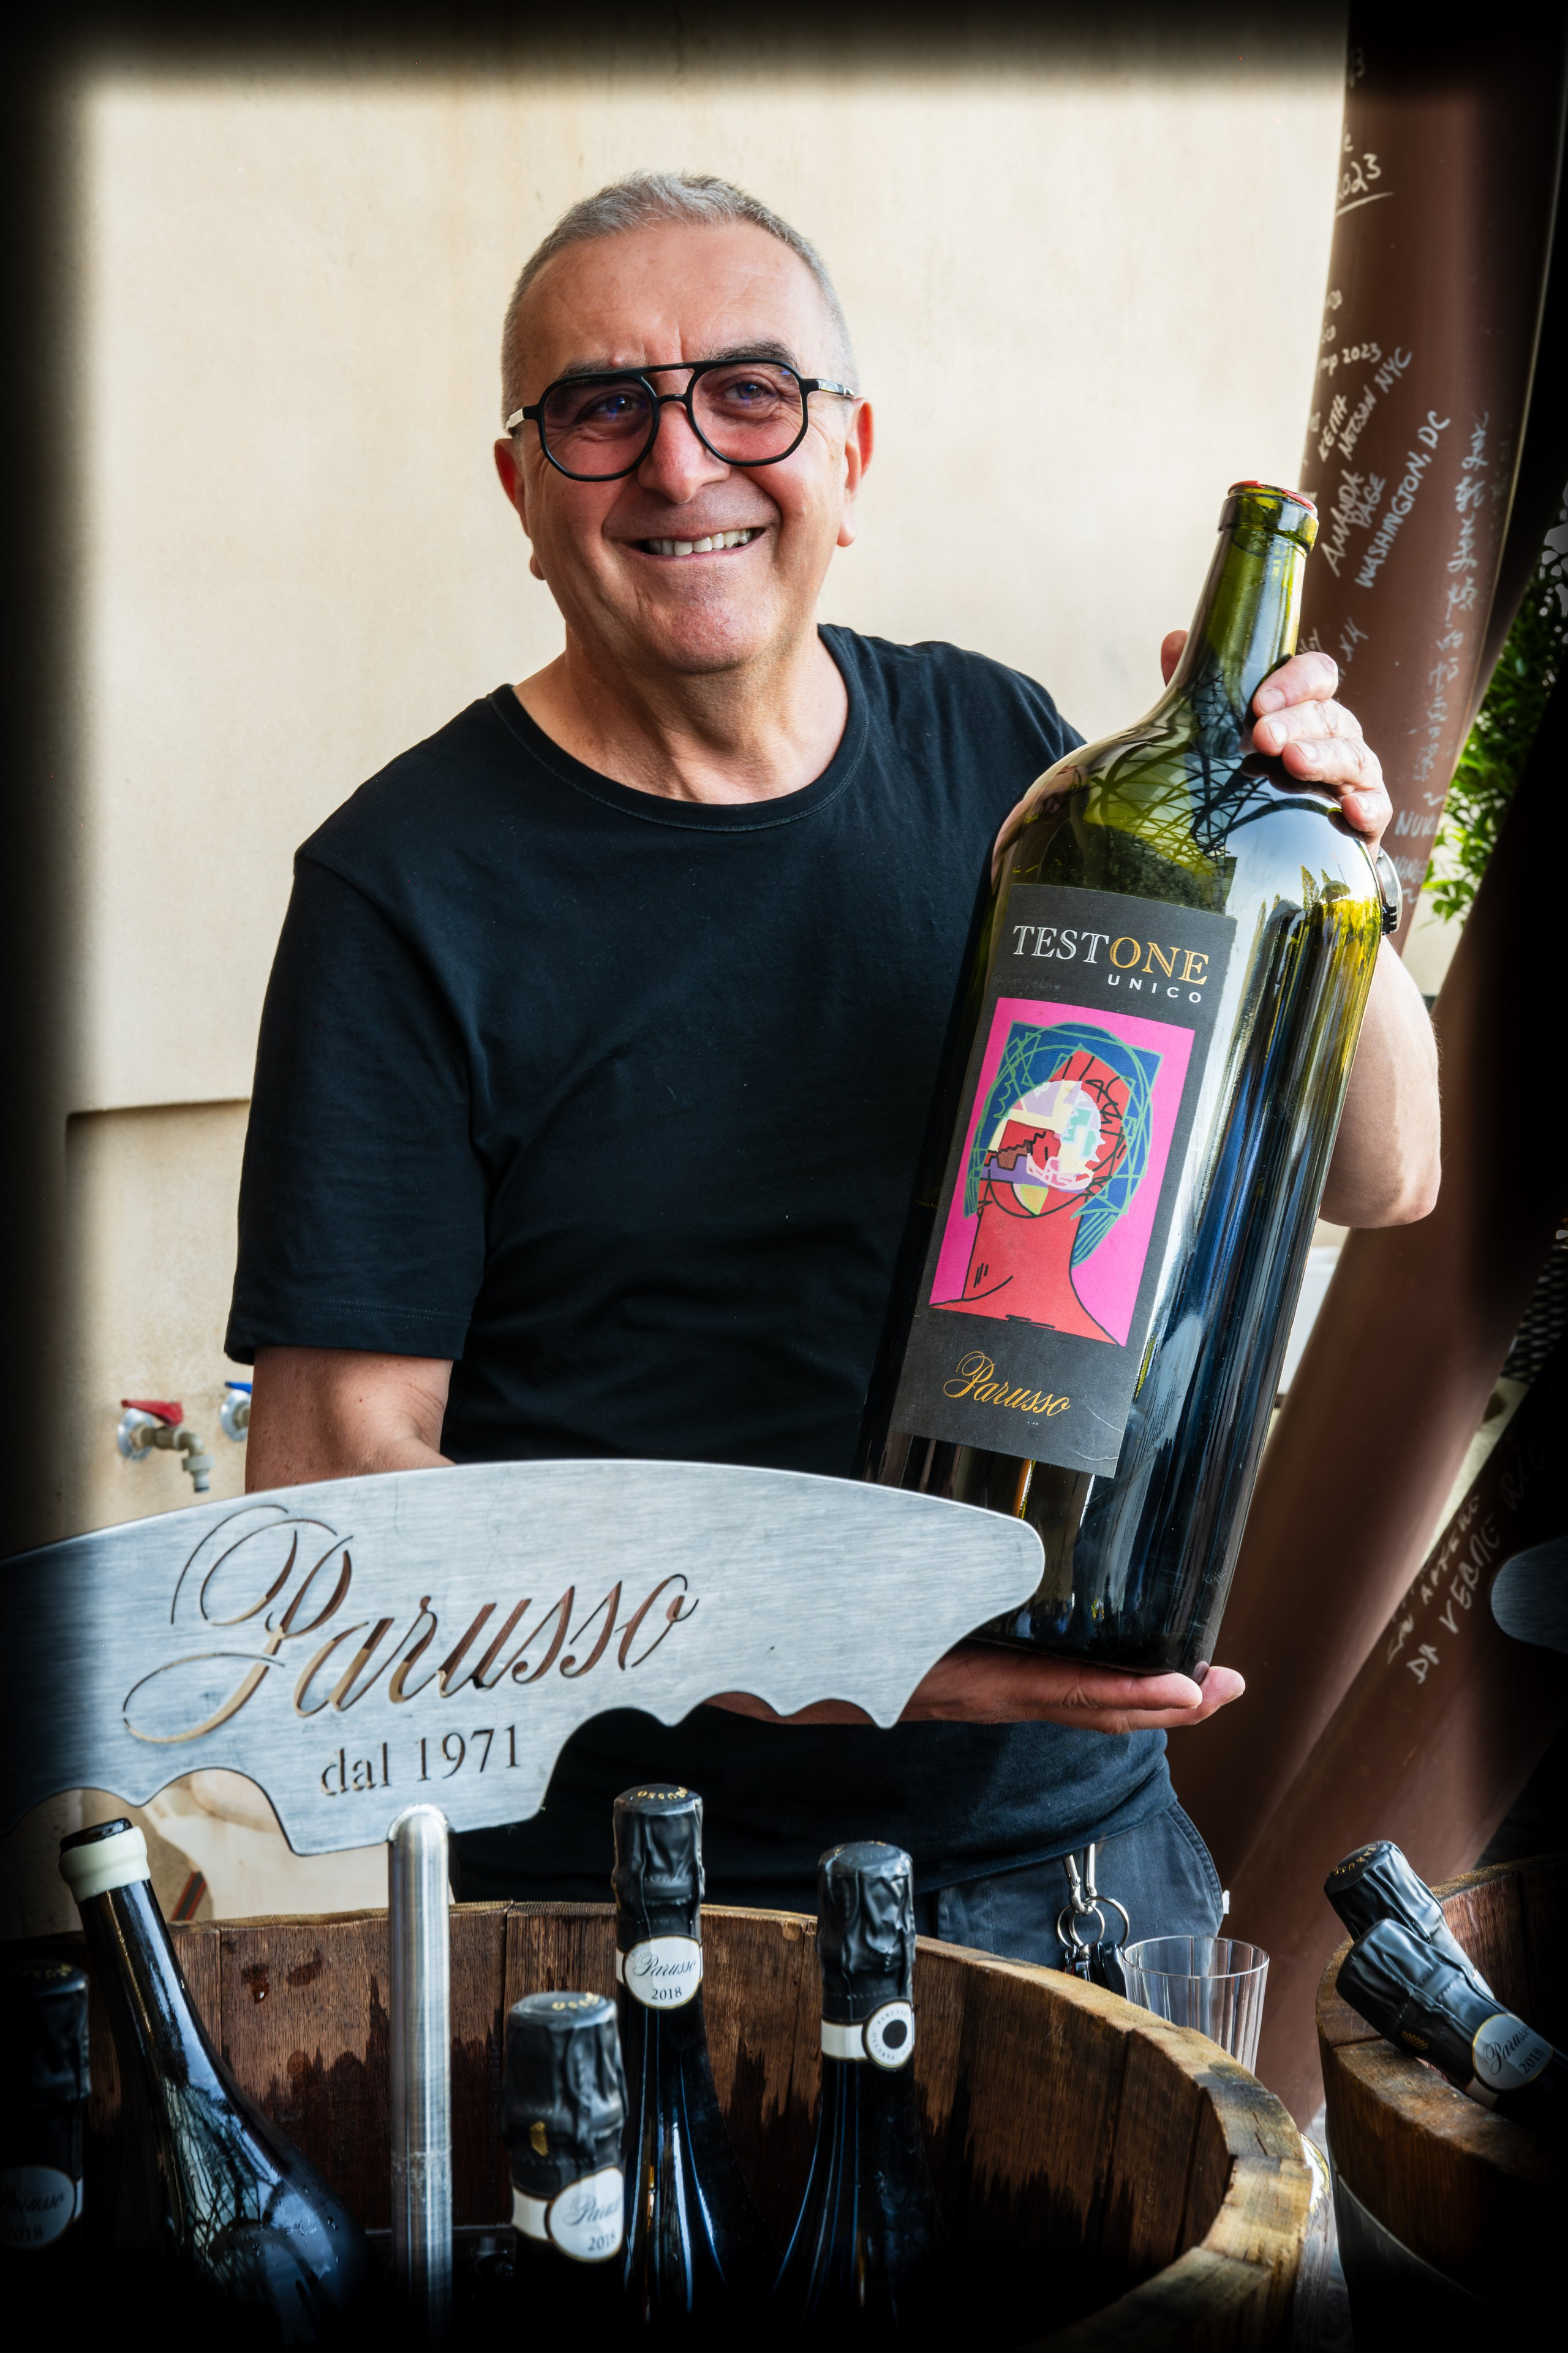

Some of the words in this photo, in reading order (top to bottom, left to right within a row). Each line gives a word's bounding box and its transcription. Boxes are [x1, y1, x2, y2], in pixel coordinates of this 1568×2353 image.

[1338, 153, 1381, 200] 023
[1342, 342, 1382, 364] 2023
[1374, 347, 1412, 394] NYC
[1354, 451, 1432, 588] WASHINGTON,
[1418, 410, 1451, 450] DC
[1012, 924, 1210, 986] TESTONE
[1107, 973, 1202, 1004] UNICO
[943, 1350, 1071, 1418] Parusso
[123, 1504, 699, 1743] Parusso
[320, 1742, 391, 1797] dal
[417, 1723, 521, 1781] 1971
[632, 1951, 696, 1977] Parusso
[650, 1987, 682, 2001] 2018
[1482, 2025, 1530, 2075] Parusso
[1518, 2047, 1544, 2074] 2018
